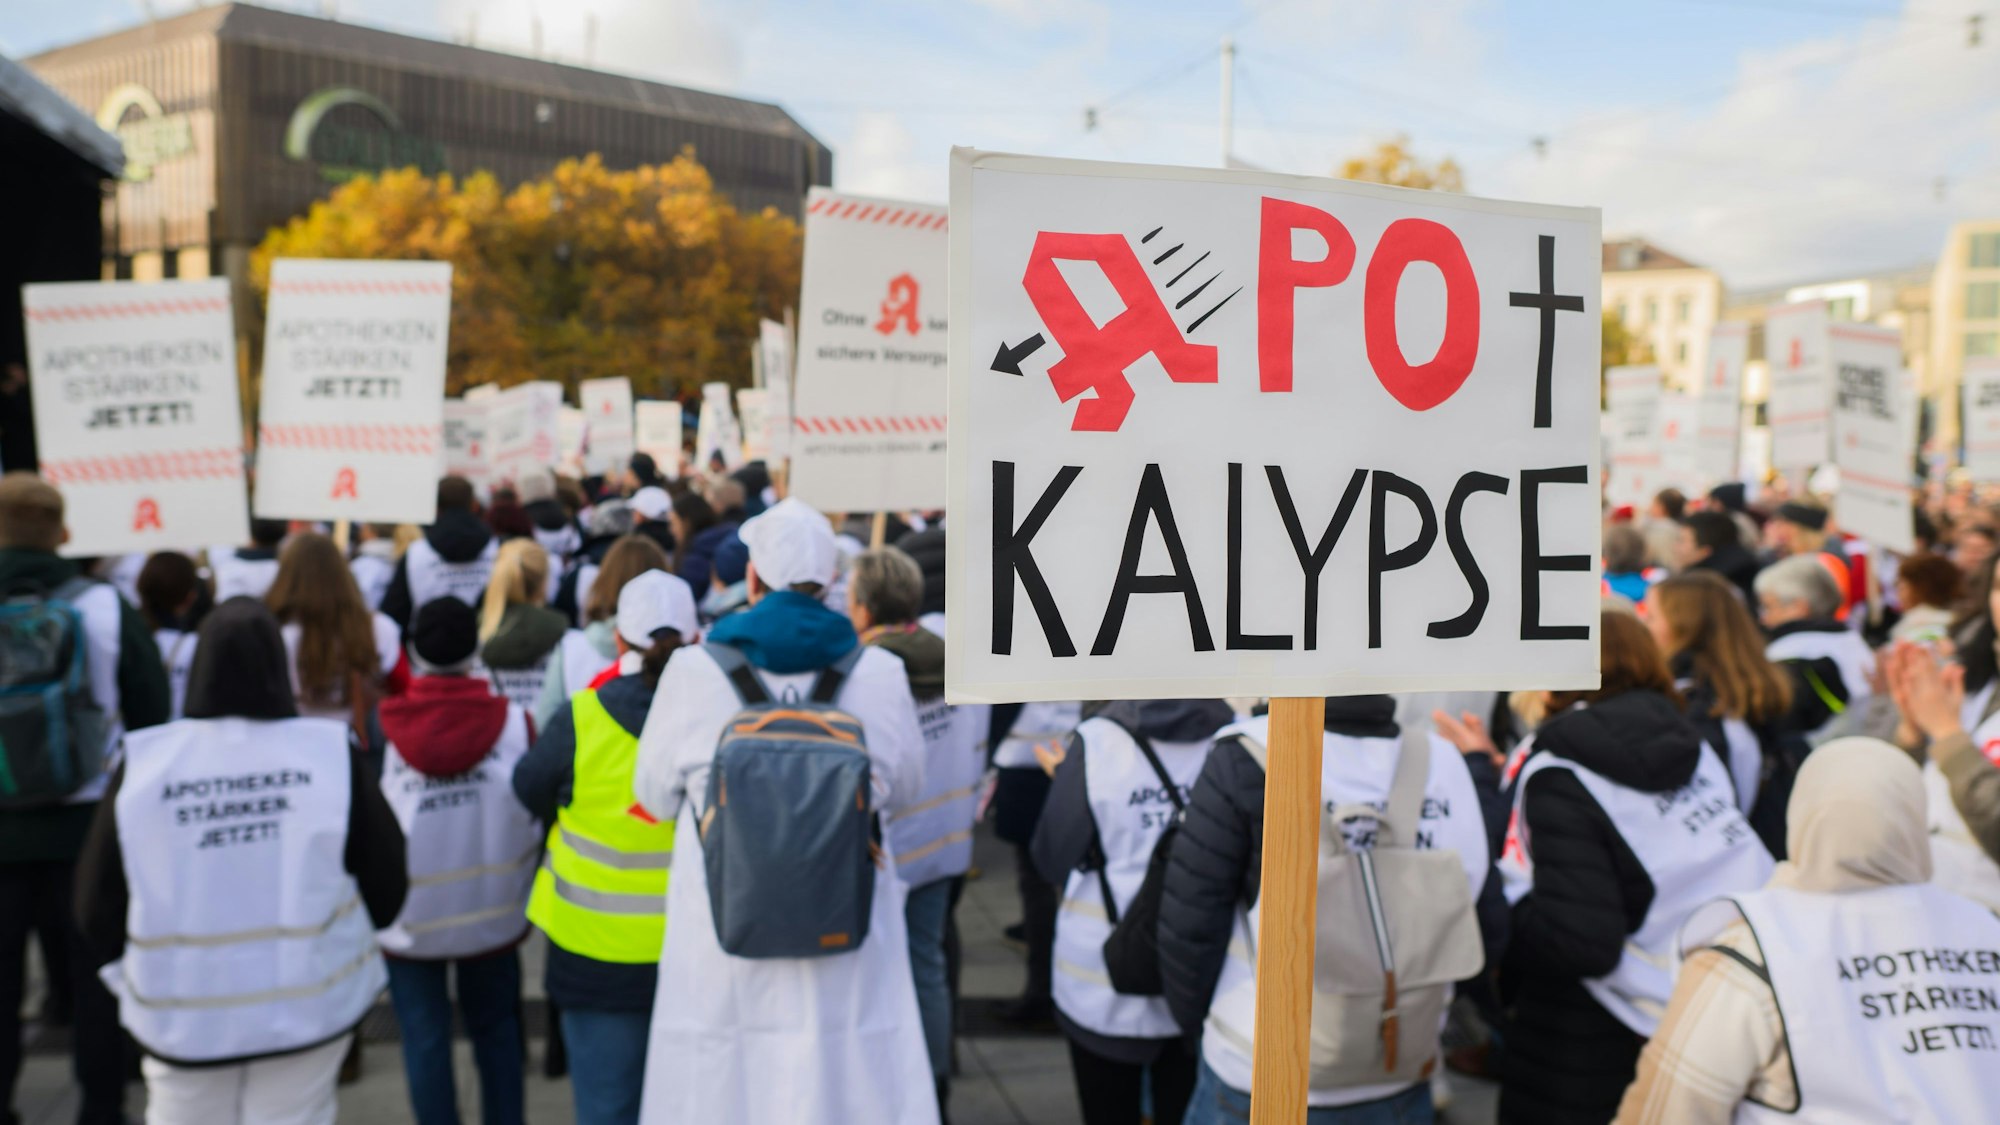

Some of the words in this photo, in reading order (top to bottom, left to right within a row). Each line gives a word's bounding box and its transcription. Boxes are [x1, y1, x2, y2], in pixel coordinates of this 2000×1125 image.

[276, 316, 437, 344] APOTHEKEN
[822, 307, 866, 326] Ohne
[43, 339, 224, 373] APOTHEKEN
[304, 375, 402, 399] JETZT!
[84, 402, 195, 430] JETZT!
[991, 461, 1592, 657] KALYPSE
[161, 769, 312, 802] APOTHEKEN
[197, 821, 281, 850] JETZT!
